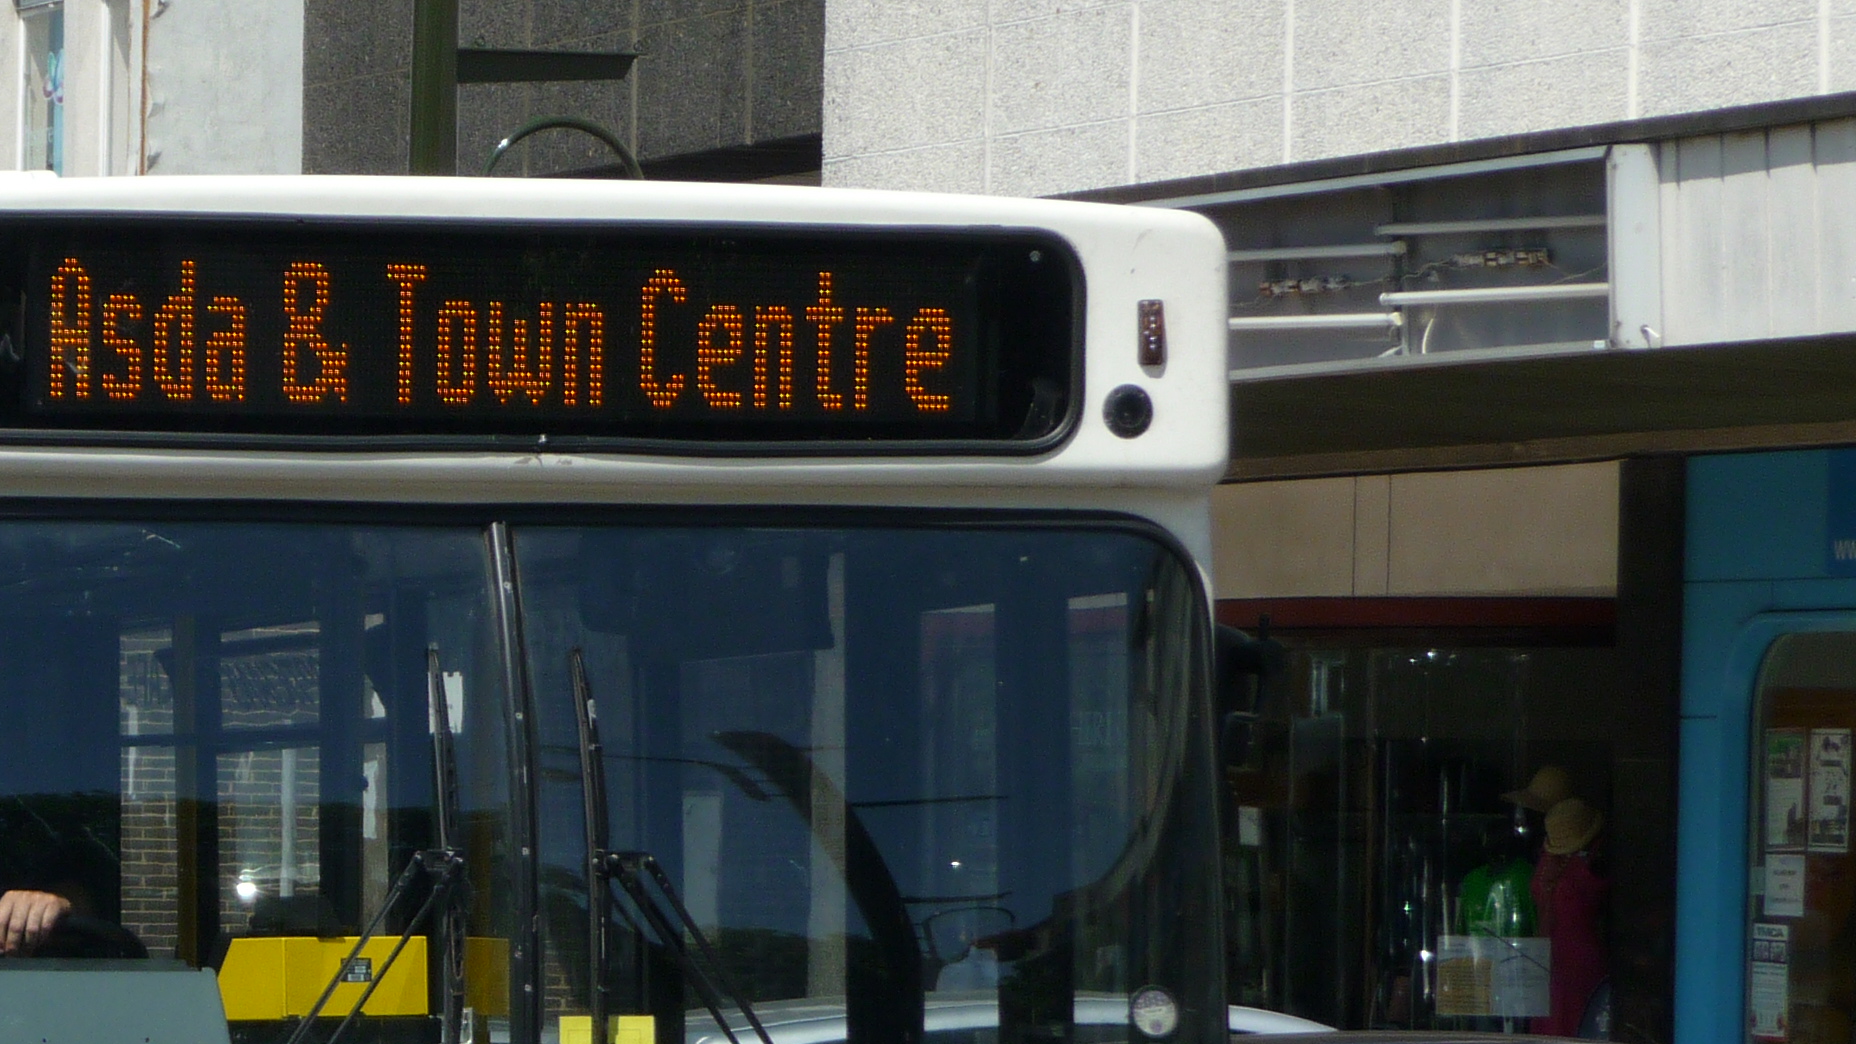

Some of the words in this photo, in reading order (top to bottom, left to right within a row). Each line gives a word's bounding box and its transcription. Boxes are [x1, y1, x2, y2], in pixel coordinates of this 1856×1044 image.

[50, 257, 245, 400] Asda
[282, 261, 348, 402] &
[387, 262, 604, 408] Town
[640, 268, 953, 412] Centre
